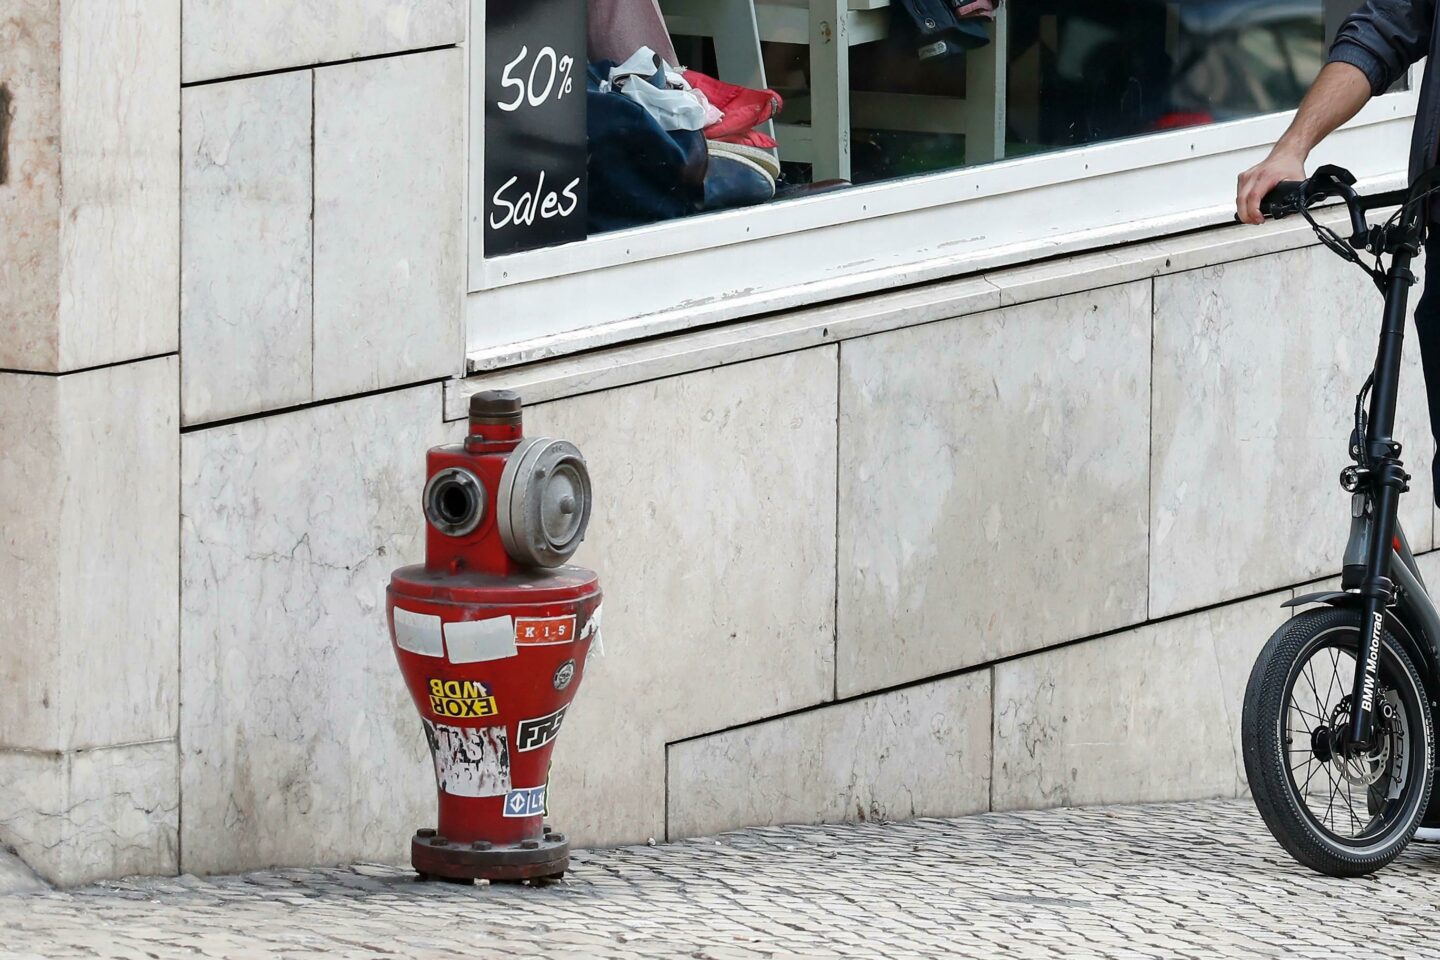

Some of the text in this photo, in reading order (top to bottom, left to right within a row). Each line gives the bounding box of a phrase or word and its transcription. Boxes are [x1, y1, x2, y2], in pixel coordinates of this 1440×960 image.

[497, 45, 574, 112] 50%
[489, 170, 580, 230] Sales
[1361, 610, 1383, 713] BMW Motorrad
[431, 696, 493, 717] EXOR
